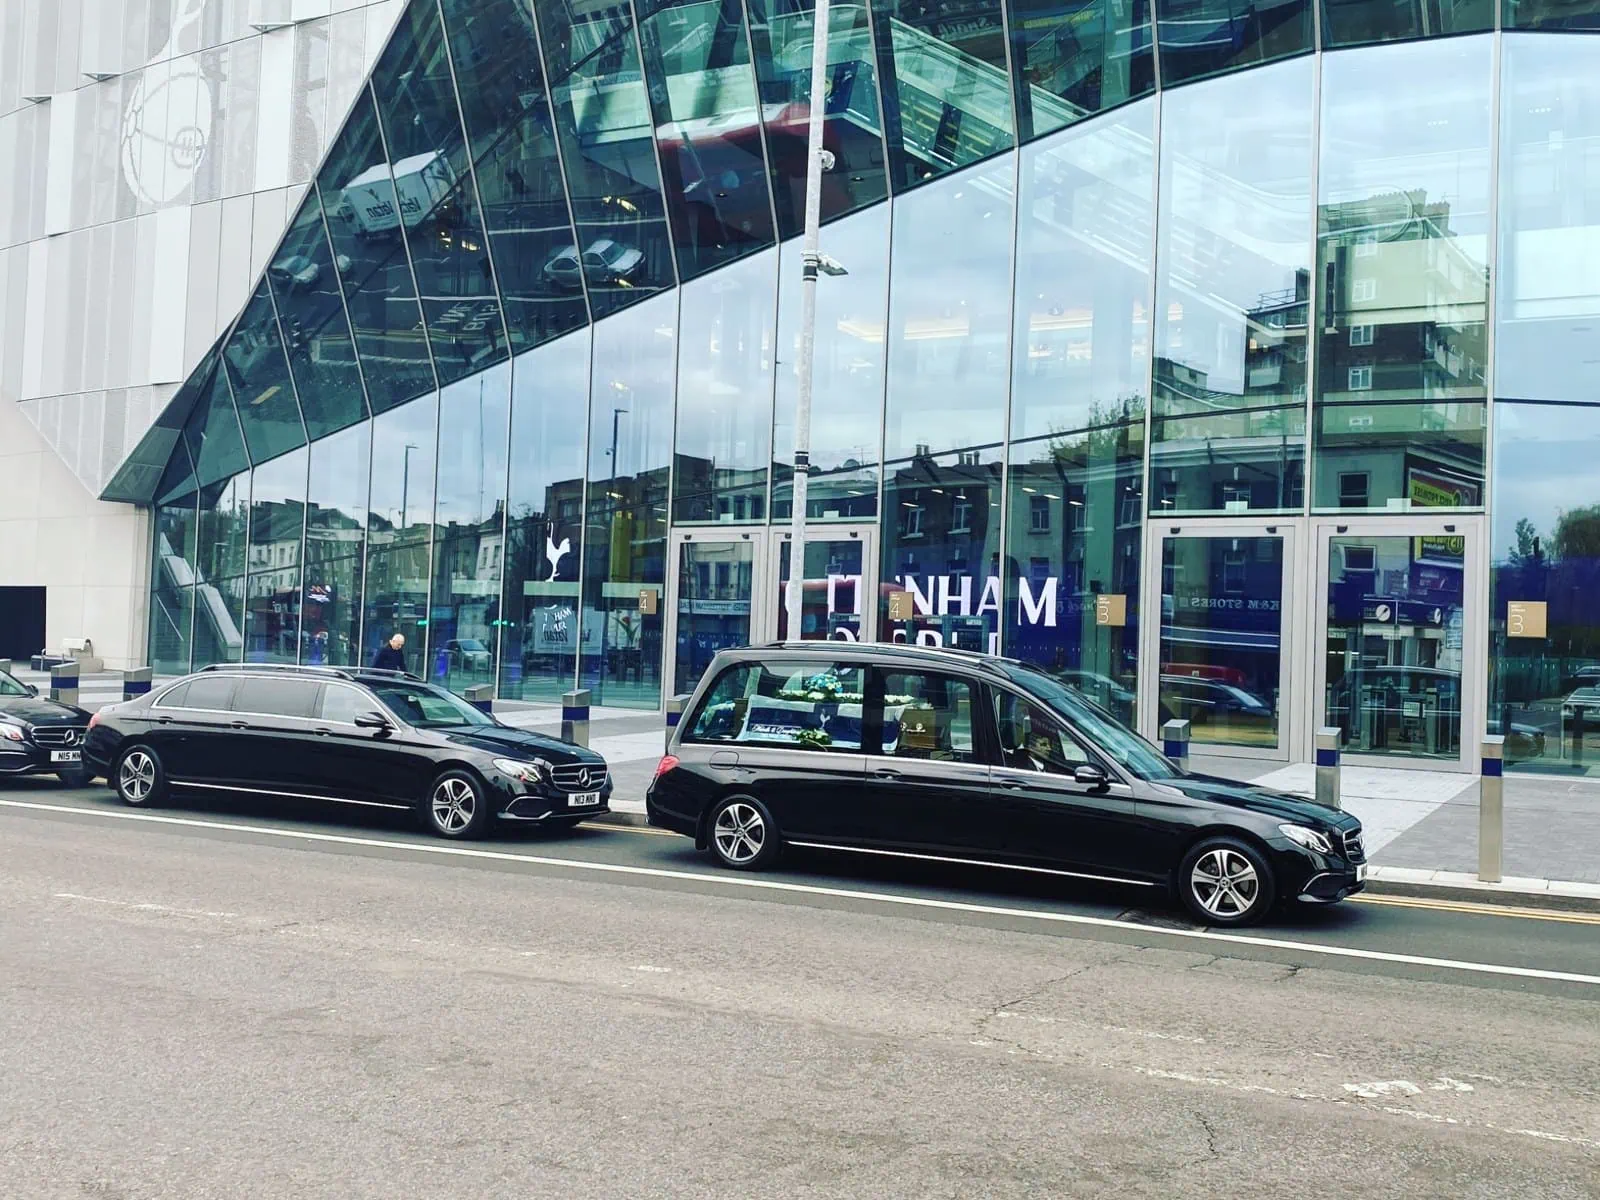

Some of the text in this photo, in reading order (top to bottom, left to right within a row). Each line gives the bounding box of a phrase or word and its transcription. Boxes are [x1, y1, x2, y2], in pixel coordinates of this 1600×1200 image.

[890, 602, 899, 617] 4
[1100, 606, 1109, 624] 3
[1511, 614, 1524, 634] 3
